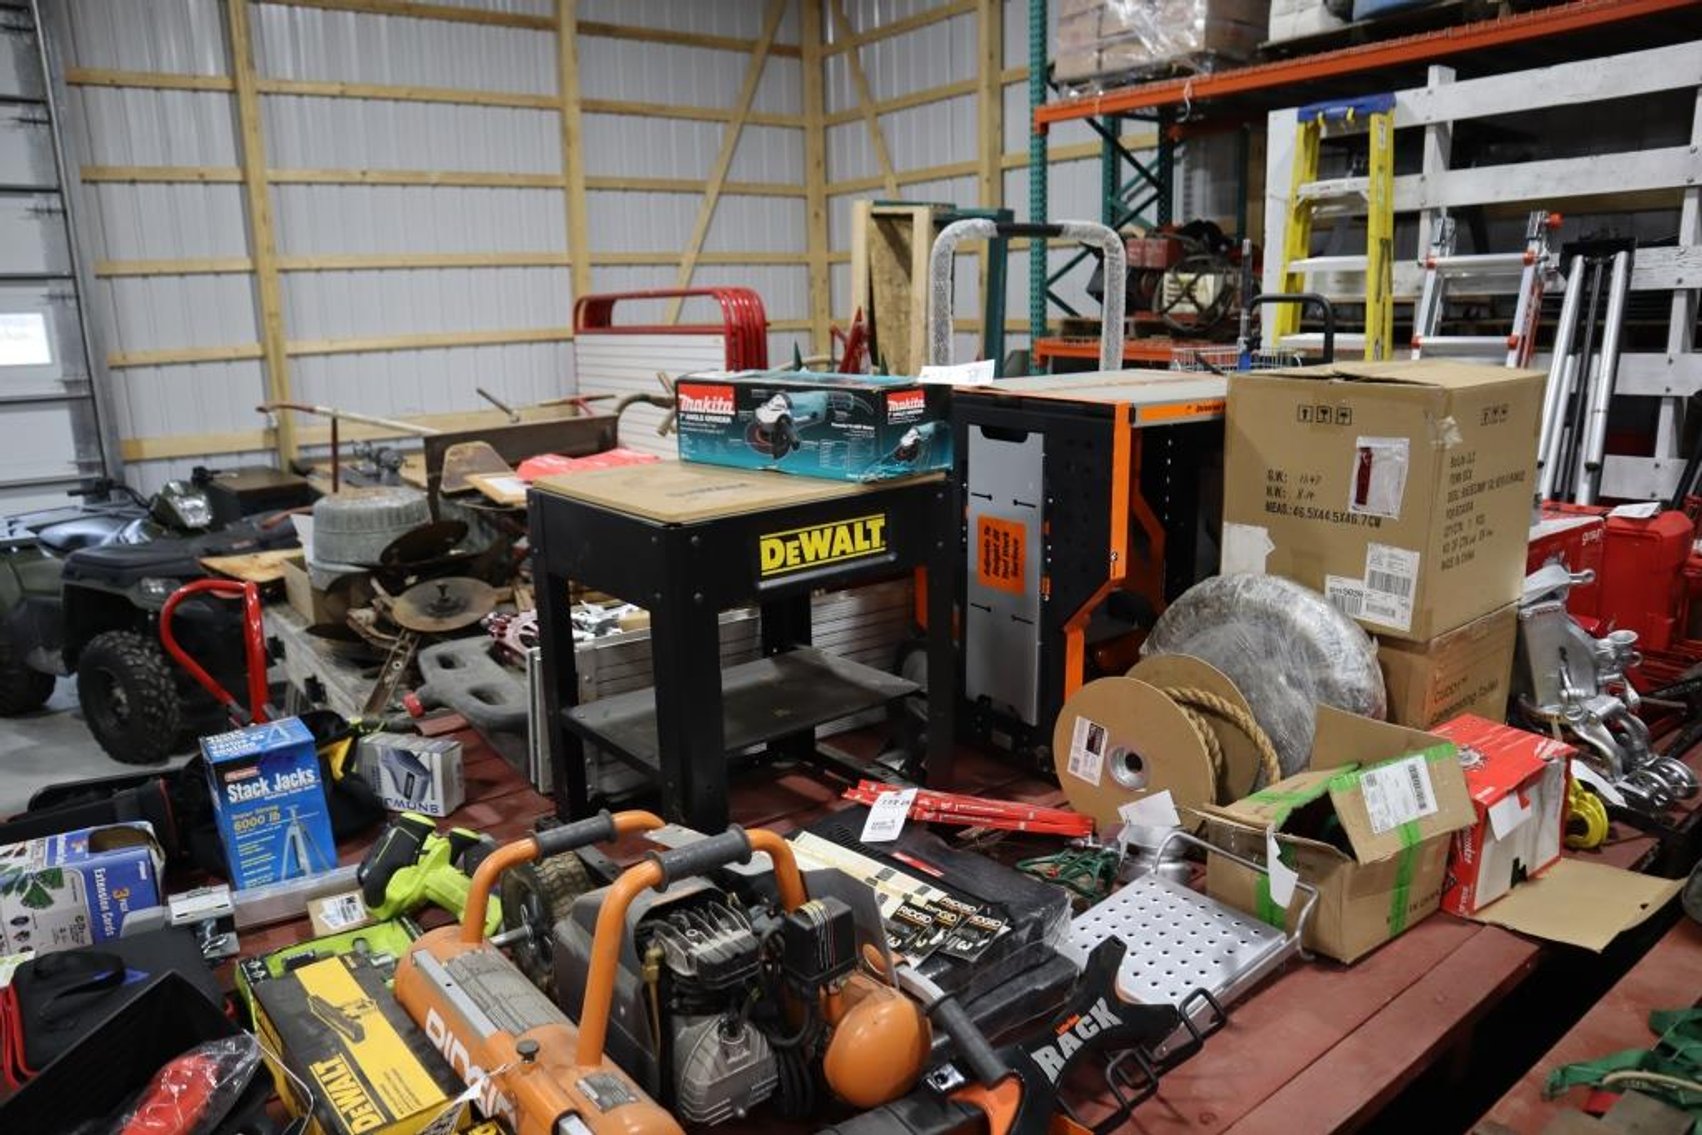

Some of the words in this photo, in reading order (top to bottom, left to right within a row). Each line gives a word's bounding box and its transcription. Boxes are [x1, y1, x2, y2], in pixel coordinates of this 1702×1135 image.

[227, 777, 271, 803] Stack
[273, 767, 315, 792] Jacks
[1031, 997, 1123, 1085] RACK
